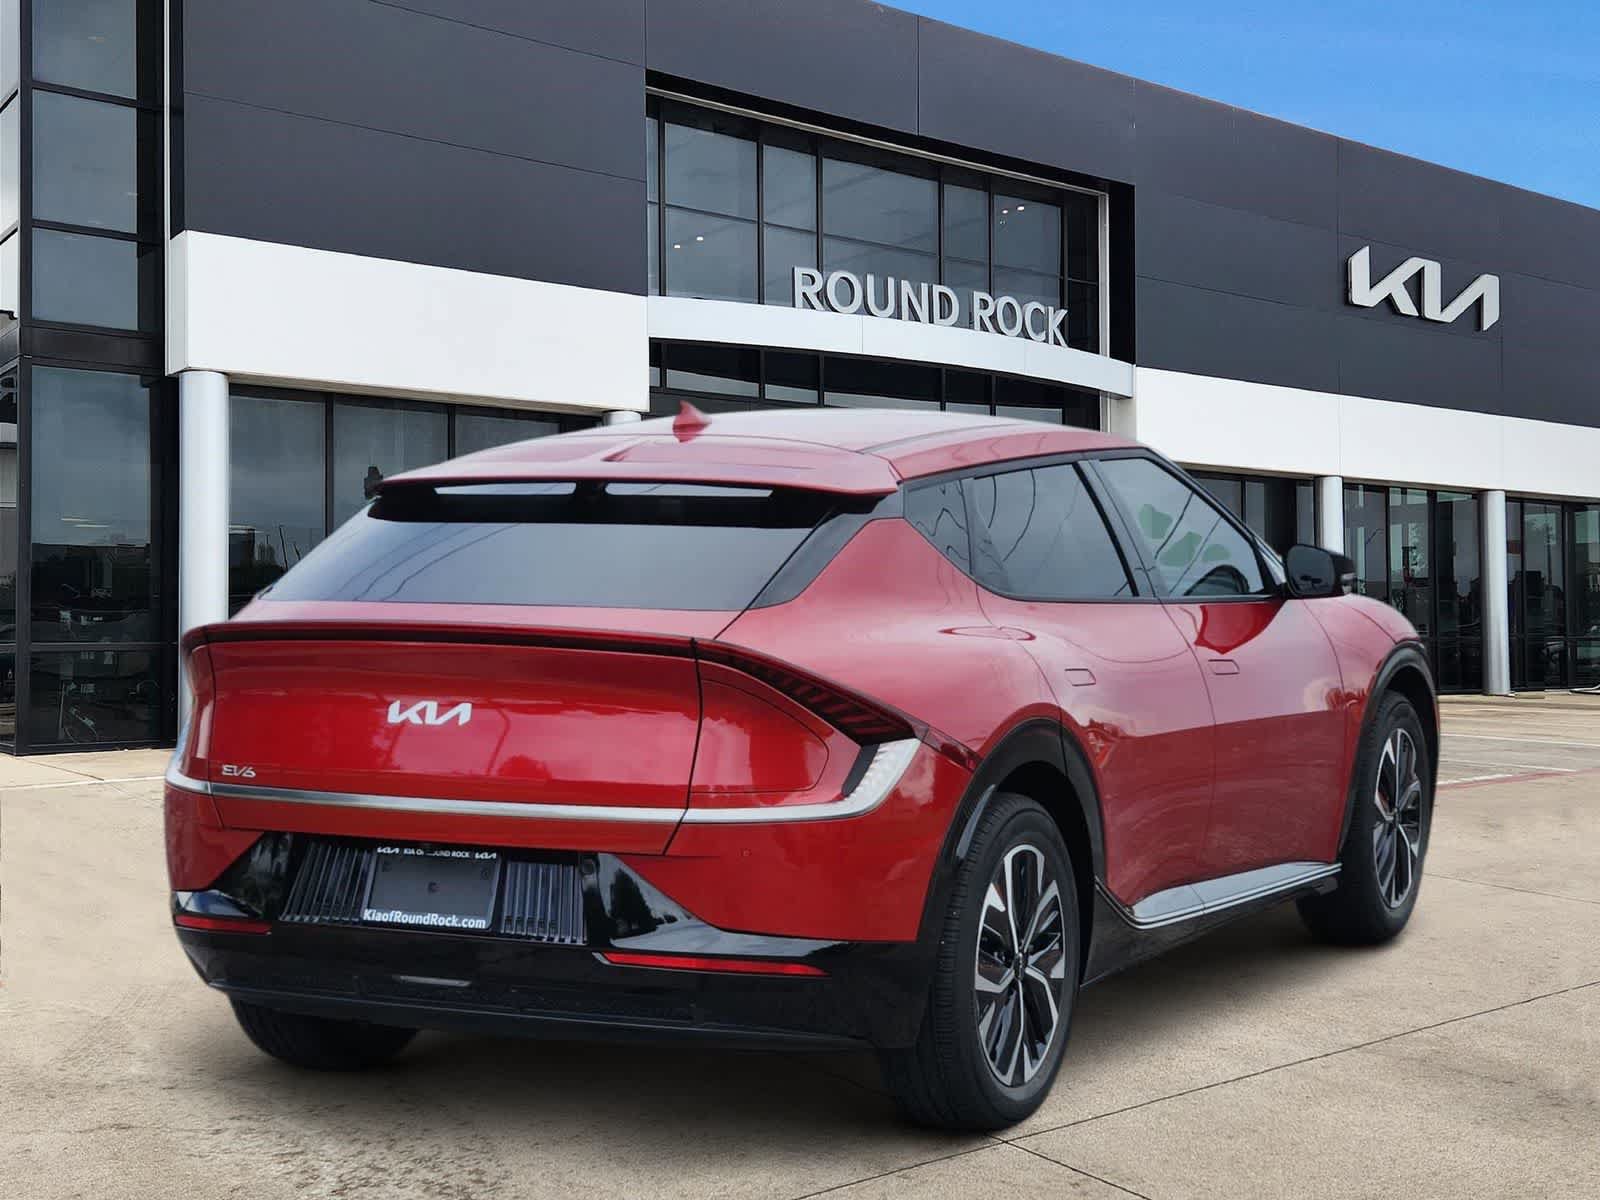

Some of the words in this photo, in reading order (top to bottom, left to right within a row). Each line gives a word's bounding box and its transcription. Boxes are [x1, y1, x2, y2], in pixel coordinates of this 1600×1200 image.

[1347, 245, 1500, 332] KIA
[793, 266, 960, 327] ROUND
[971, 290, 1069, 348] ROCK
[387, 700, 472, 726] KIA
[222, 764, 257, 778] EV6
[363, 908, 486, 929] KiaofRoundRock.com
